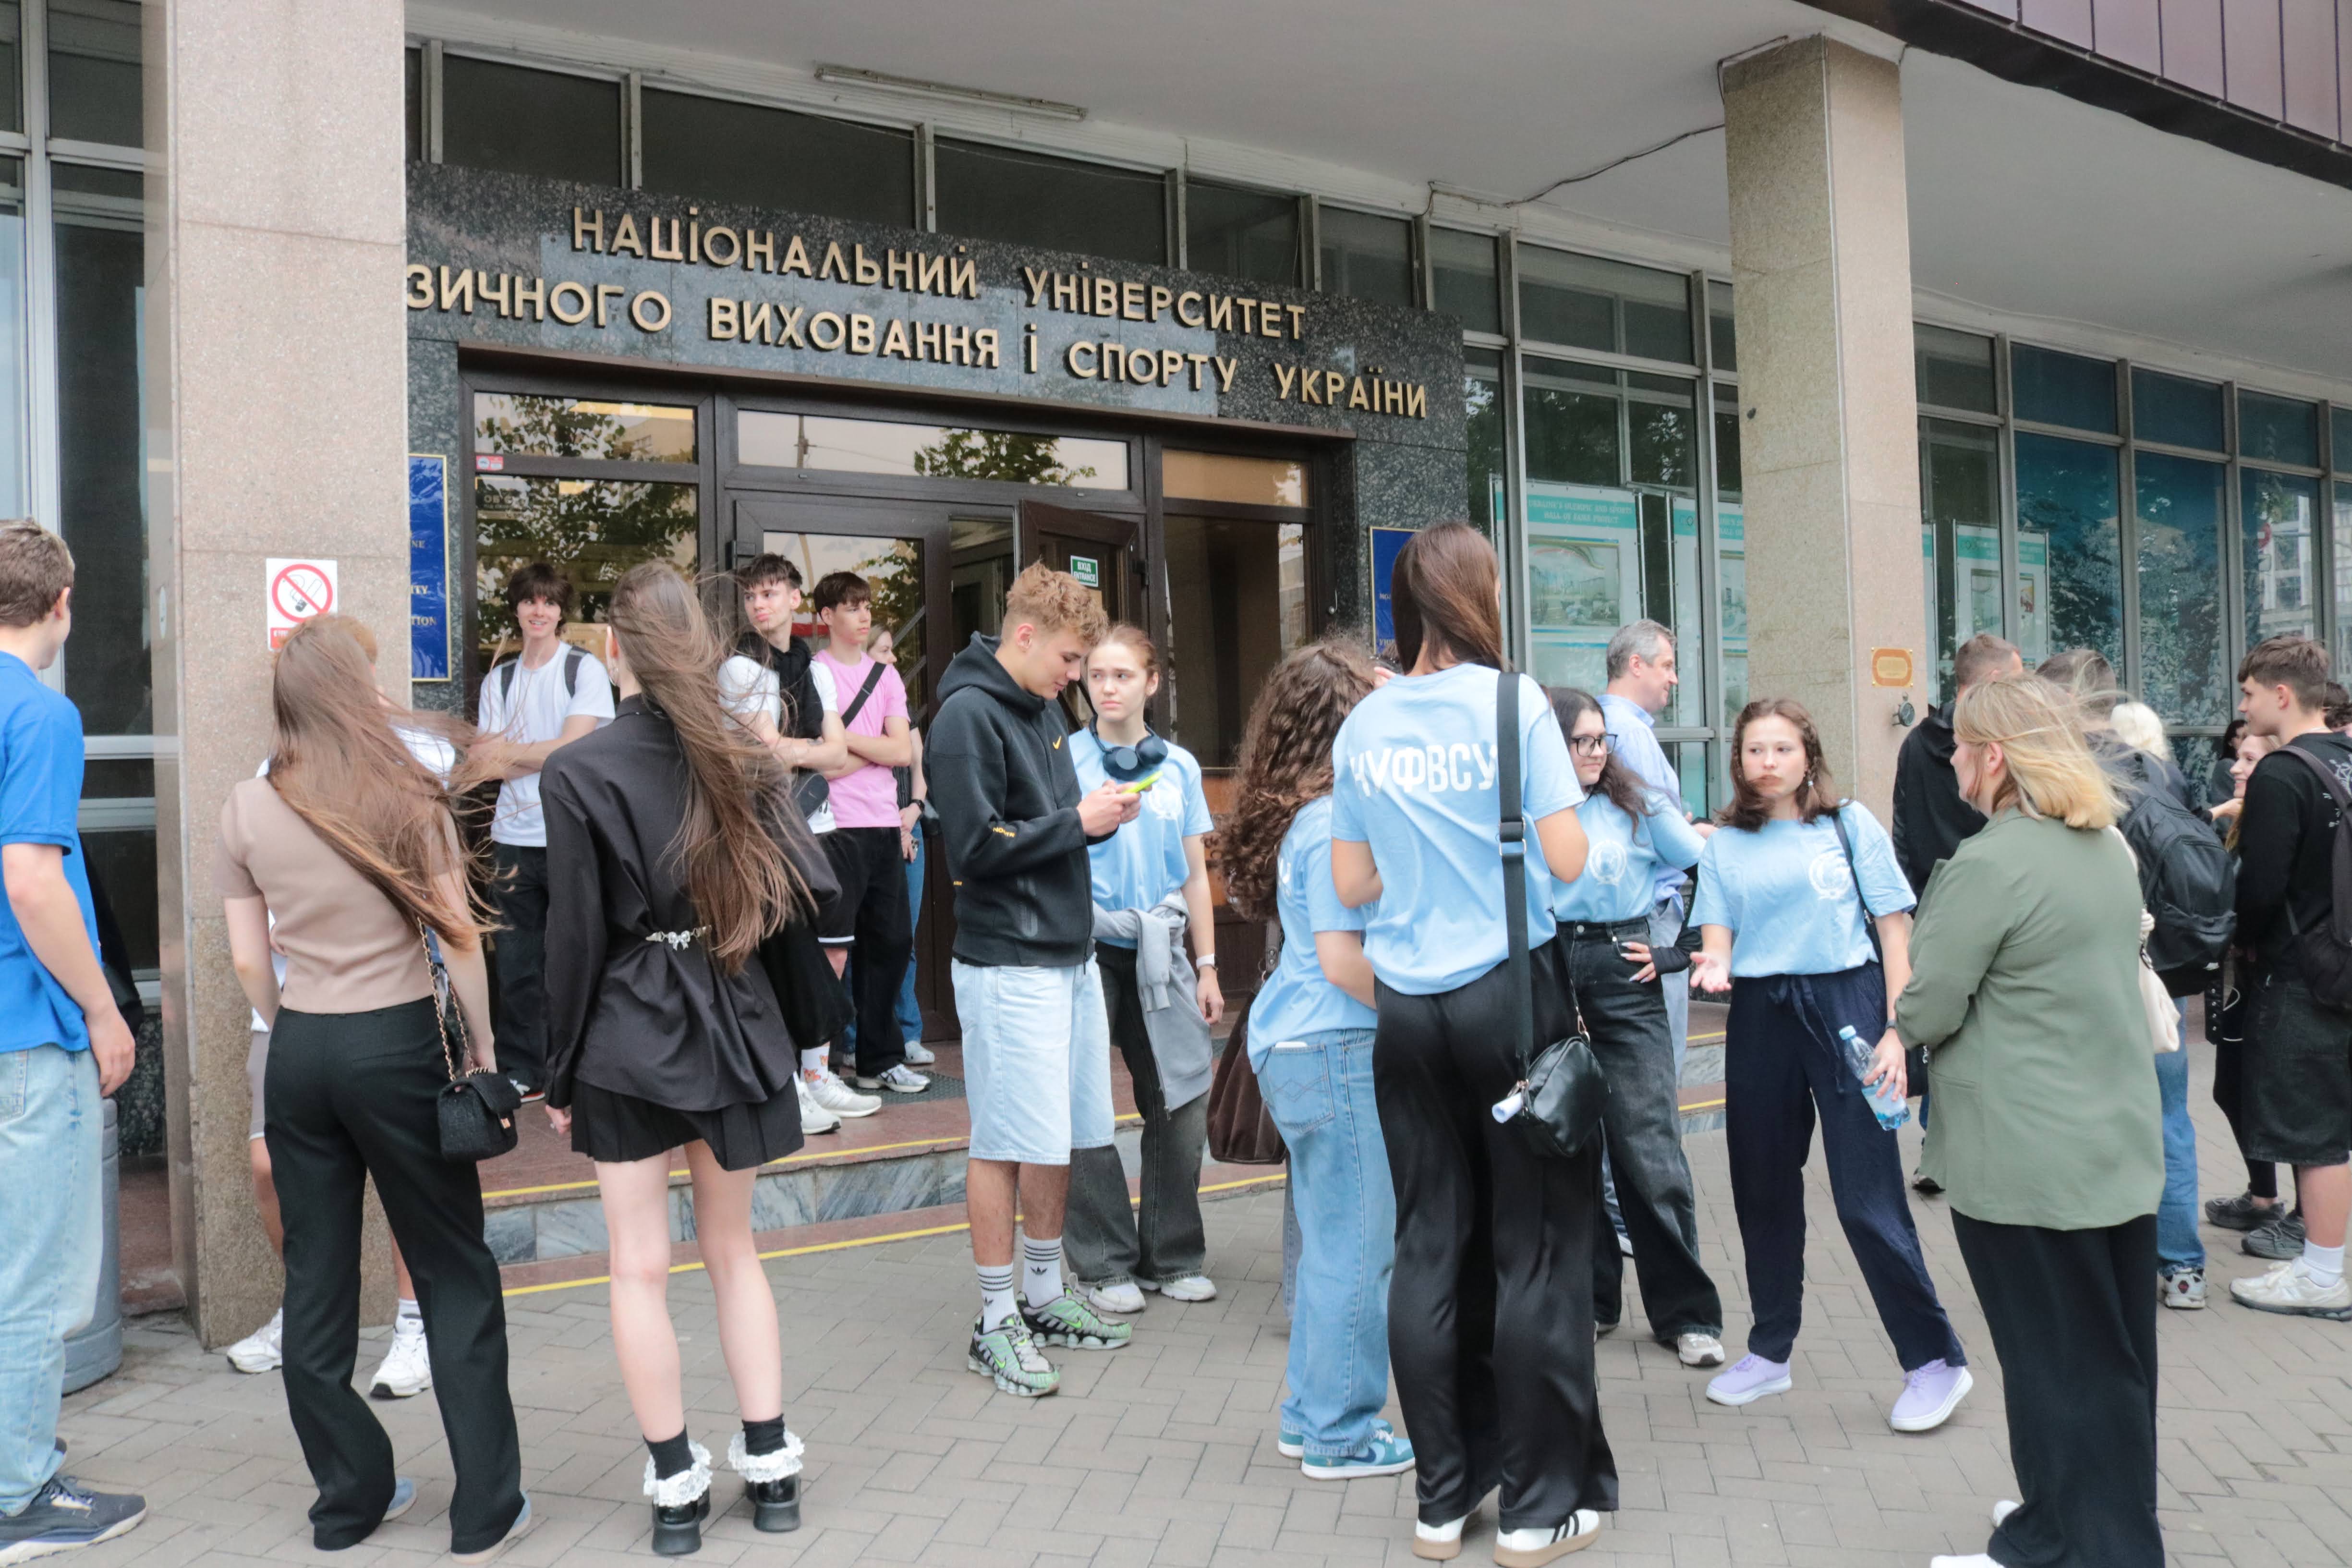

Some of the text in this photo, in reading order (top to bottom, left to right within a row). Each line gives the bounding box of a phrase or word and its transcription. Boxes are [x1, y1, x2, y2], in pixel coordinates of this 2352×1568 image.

[574, 207, 1305, 340] НАЦІОНАЛЬНИЙ УНІВЕРСИТЕТ
[710, 298, 998, 368] ВИХОВАННЯ
[1068, 341, 1237, 392] СПОРТУ
[1274, 366, 1427, 419] УКРАЇНИ
[1077, 561, 1091, 573] ВХІД
[1350, 742, 1498, 799] НУФВСУ
